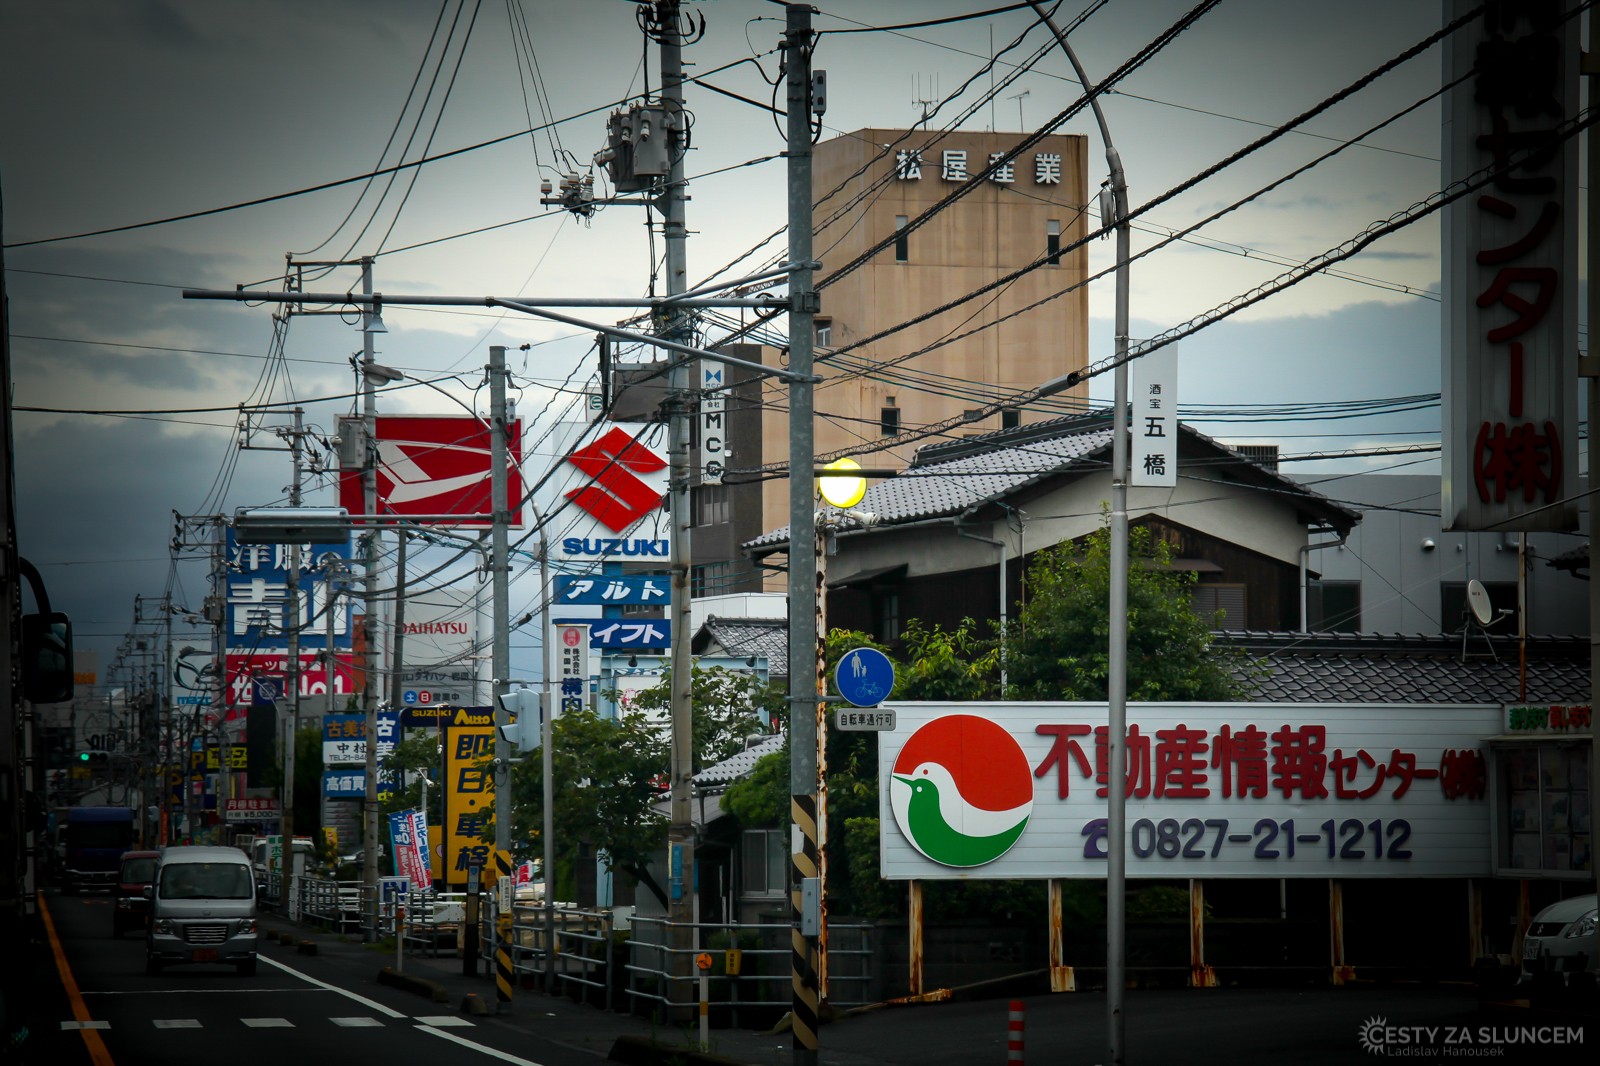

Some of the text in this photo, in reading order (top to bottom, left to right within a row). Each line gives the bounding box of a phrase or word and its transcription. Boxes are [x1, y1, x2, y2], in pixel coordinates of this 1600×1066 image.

[896, 149, 1062, 184] 松屋産業
[1143, 416, 1166, 475] 五橋
[562, 538, 670, 556] SUZUKI
[567, 580, 665, 601] アルト
[227, 578, 347, 635] 青山
[590, 622, 665, 644] イフト
[411, 709, 452, 717] SUZUKI
[840, 713, 893, 726] 自転車通行可
[1034, 722, 1487, 801] 不動産情報センター(株)
[326, 776, 367, 792] 高価買
[1131, 818, 1413, 860] 0827-21-1212
